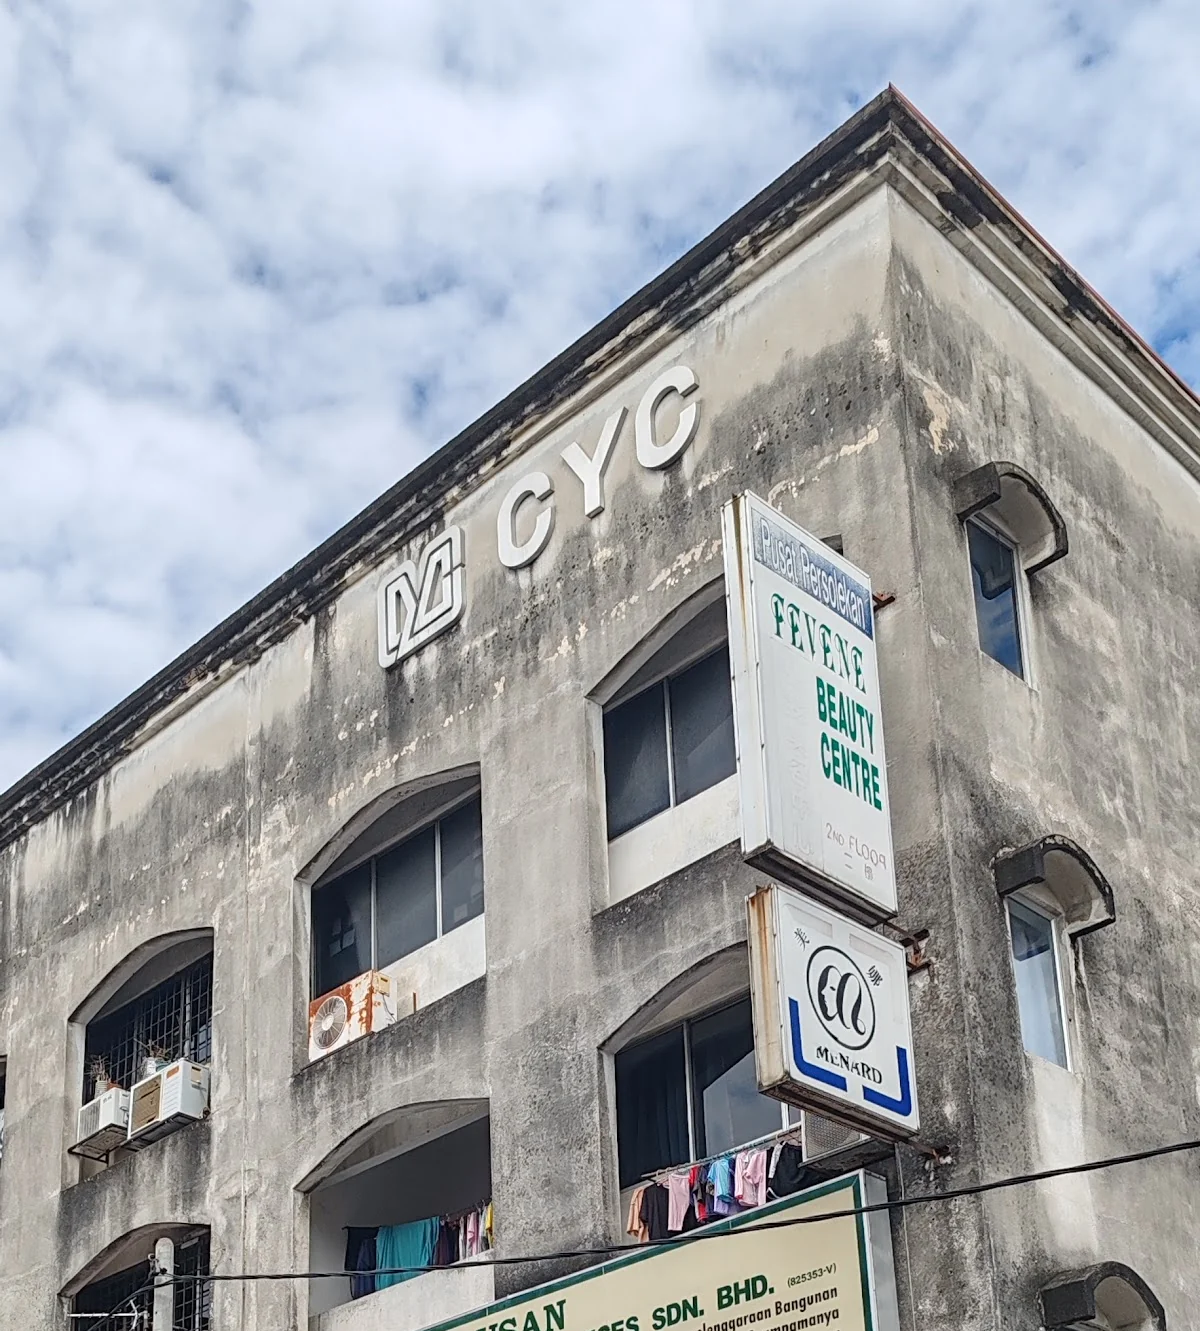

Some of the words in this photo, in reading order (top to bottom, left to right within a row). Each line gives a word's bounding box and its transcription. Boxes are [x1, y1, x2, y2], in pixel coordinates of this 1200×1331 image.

[498, 365, 699, 568] CYC
[760, 517, 799, 583] Pusat
[800, 545, 866, 630] Persolekan
[770, 593, 866, 694] FEVENE
[815, 676, 873, 754] BEAUTY
[820, 731, 882, 811] CENTRE
[825, 822, 845, 847] 2ND
[816, 1045, 883, 1084] MENARD
[651, 1295, 704, 1331] SDN.
[717, 1274, 775, 1311] BHD.
[787, 1262, 837, 1288] (825353-V)
[775, 1287, 838, 1316] Bangunan
